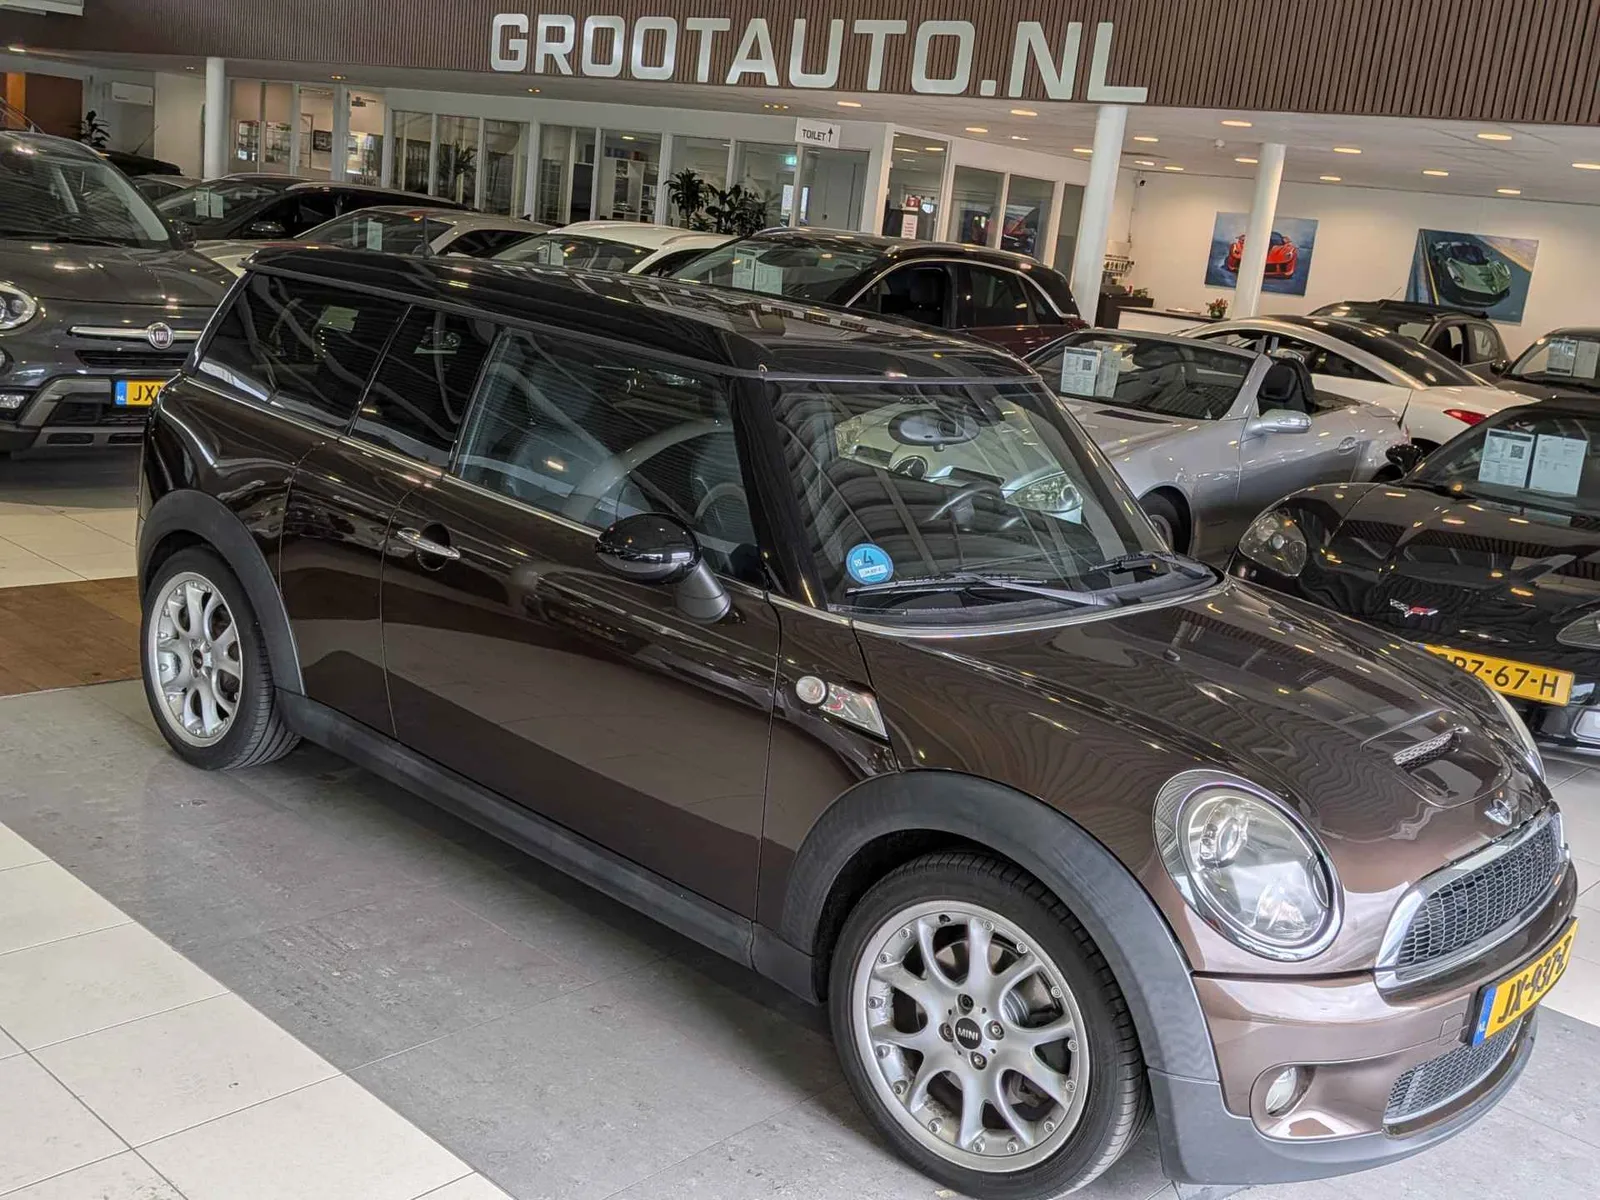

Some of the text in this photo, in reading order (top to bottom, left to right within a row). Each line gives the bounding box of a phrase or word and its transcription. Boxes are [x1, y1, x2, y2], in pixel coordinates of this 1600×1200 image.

[491, 13, 1148, 103] GROOTAUTO.NL
[802, 128, 826, 141] TOILET
[133, 385, 161, 402] JX
[957, 1027, 979, 1041] MINI
